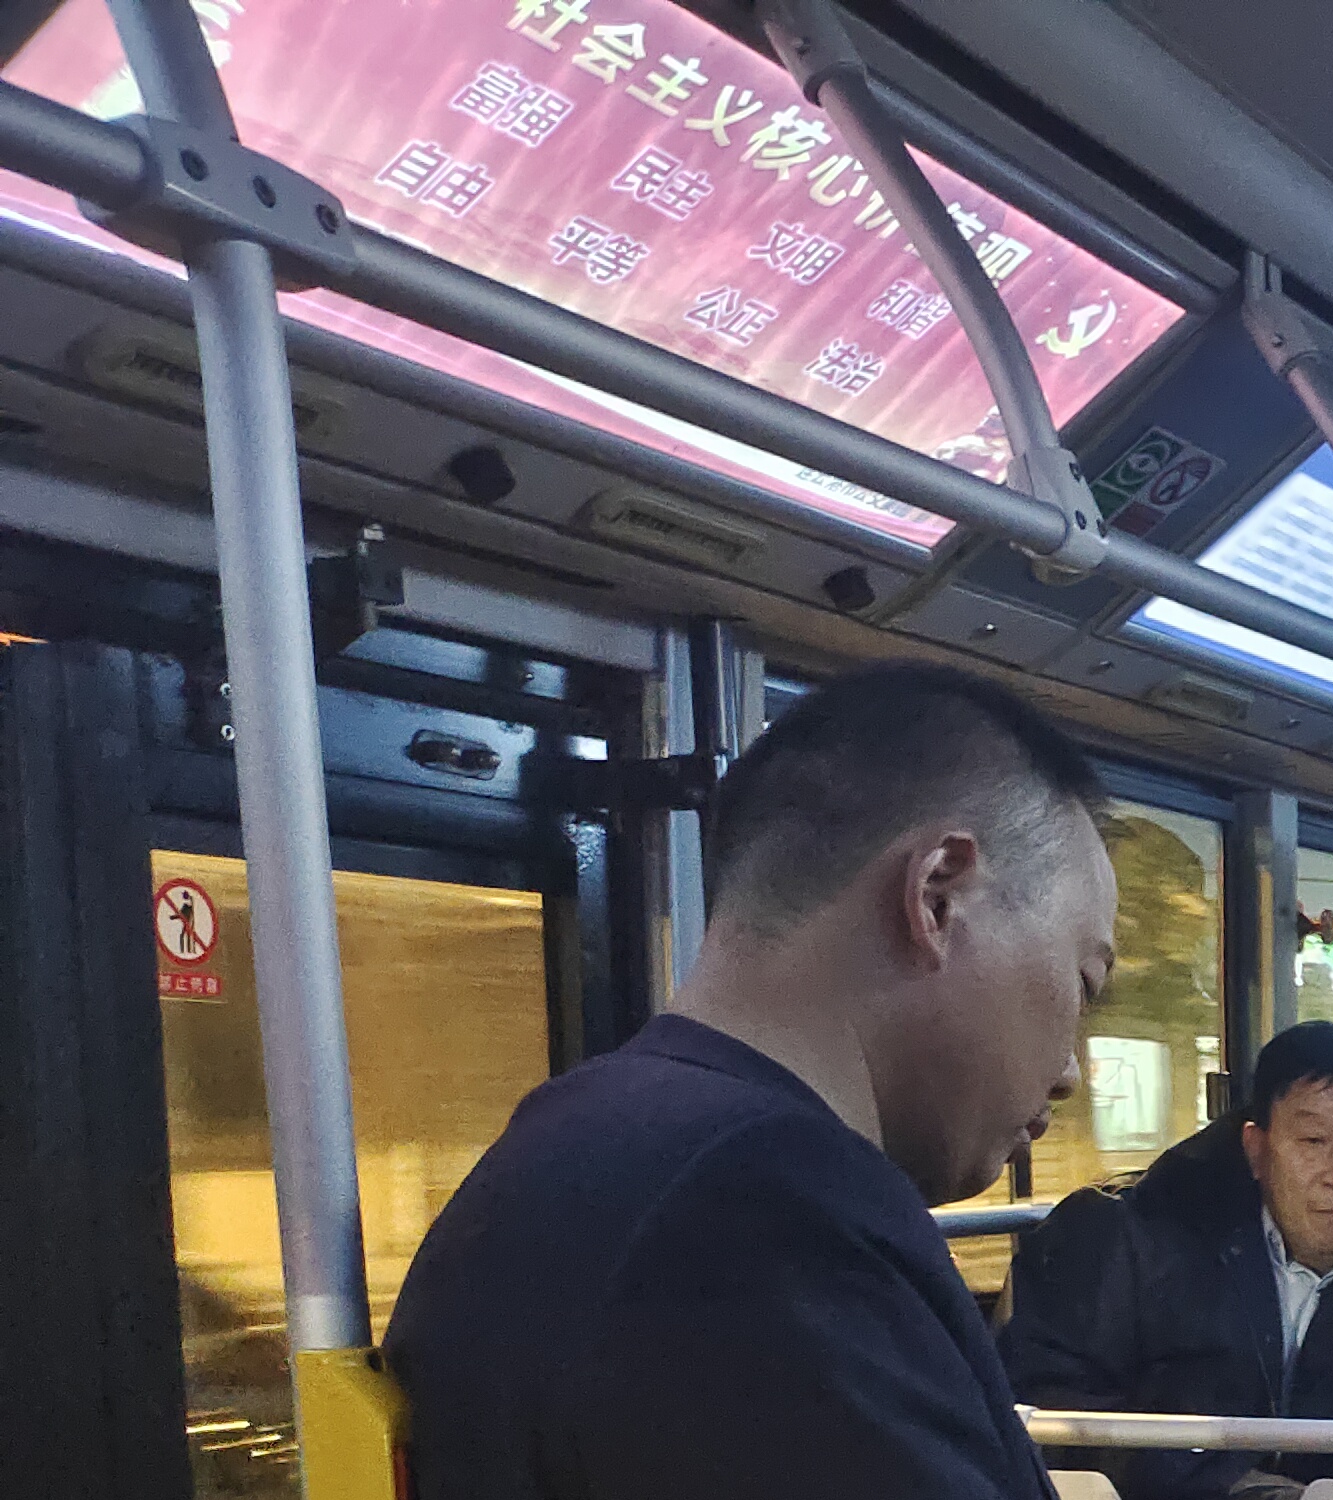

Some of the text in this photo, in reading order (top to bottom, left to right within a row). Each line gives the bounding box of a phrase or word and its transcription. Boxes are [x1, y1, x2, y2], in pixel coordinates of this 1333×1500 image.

[374, 138, 886, 397] 自由 平等 公正 法治
[450, 60, 952, 340] 富强 民主 文明 和谐
